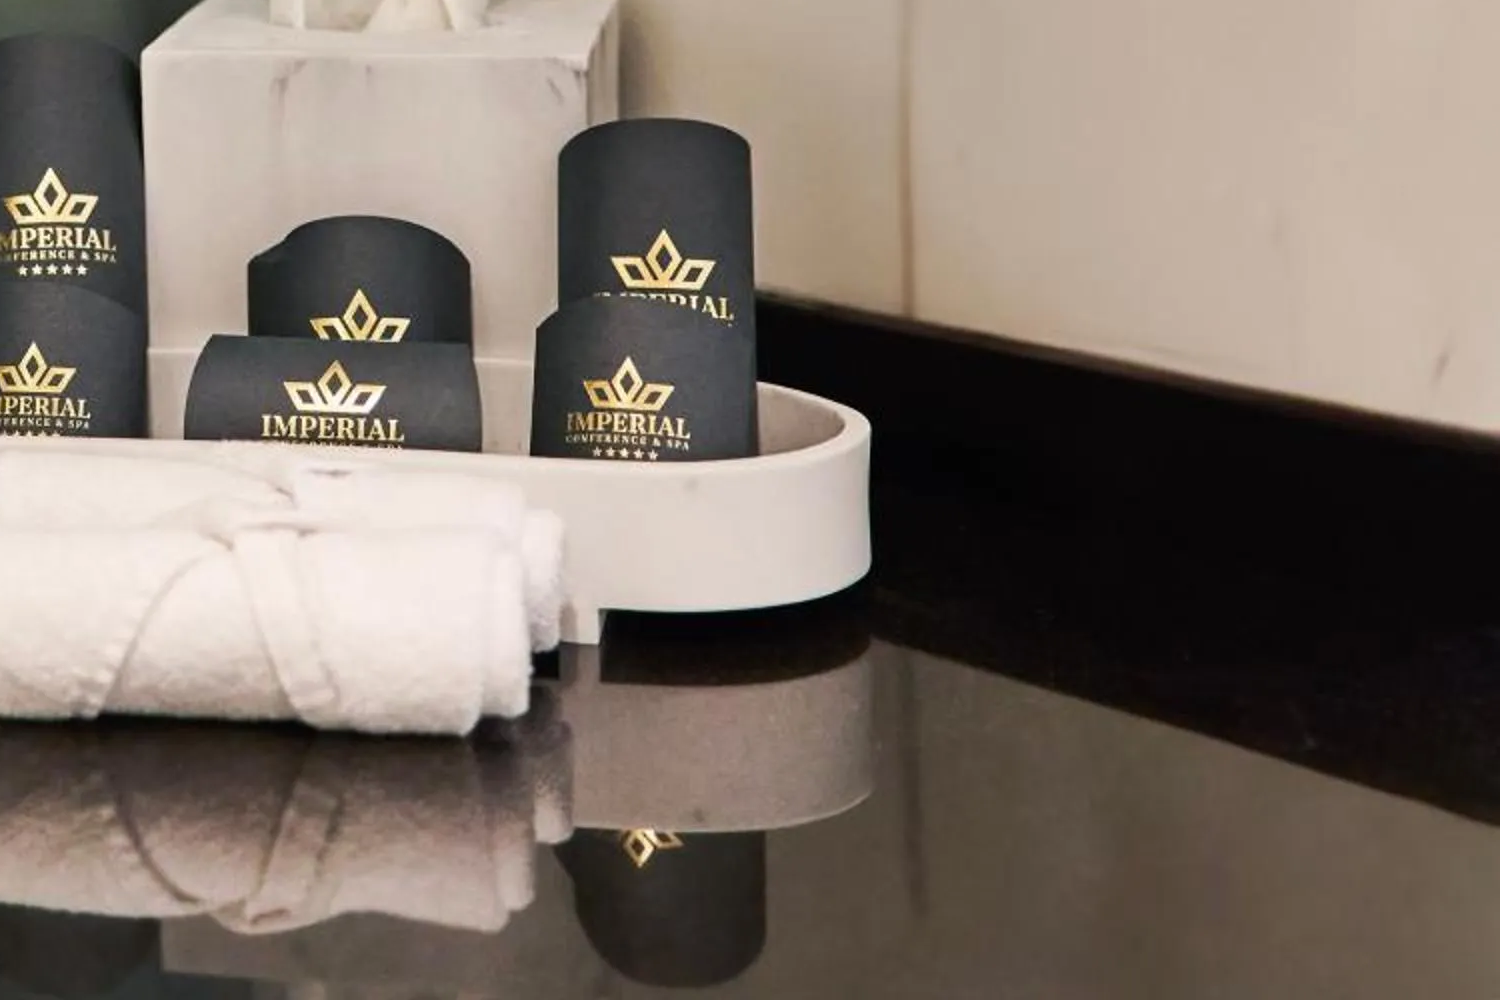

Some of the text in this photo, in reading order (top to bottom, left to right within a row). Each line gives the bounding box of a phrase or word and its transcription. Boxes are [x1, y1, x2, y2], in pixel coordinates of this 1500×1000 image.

[81, 250, 91, 261] &
[95, 251, 117, 263] SPA
[68, 419, 90, 430] SPA
[261, 414, 405, 442] IMPERIAL
[567, 411, 691, 439] IMPERIAL
[565, 433, 647, 445] CONFERENCE
[666, 439, 690, 451] SPA
